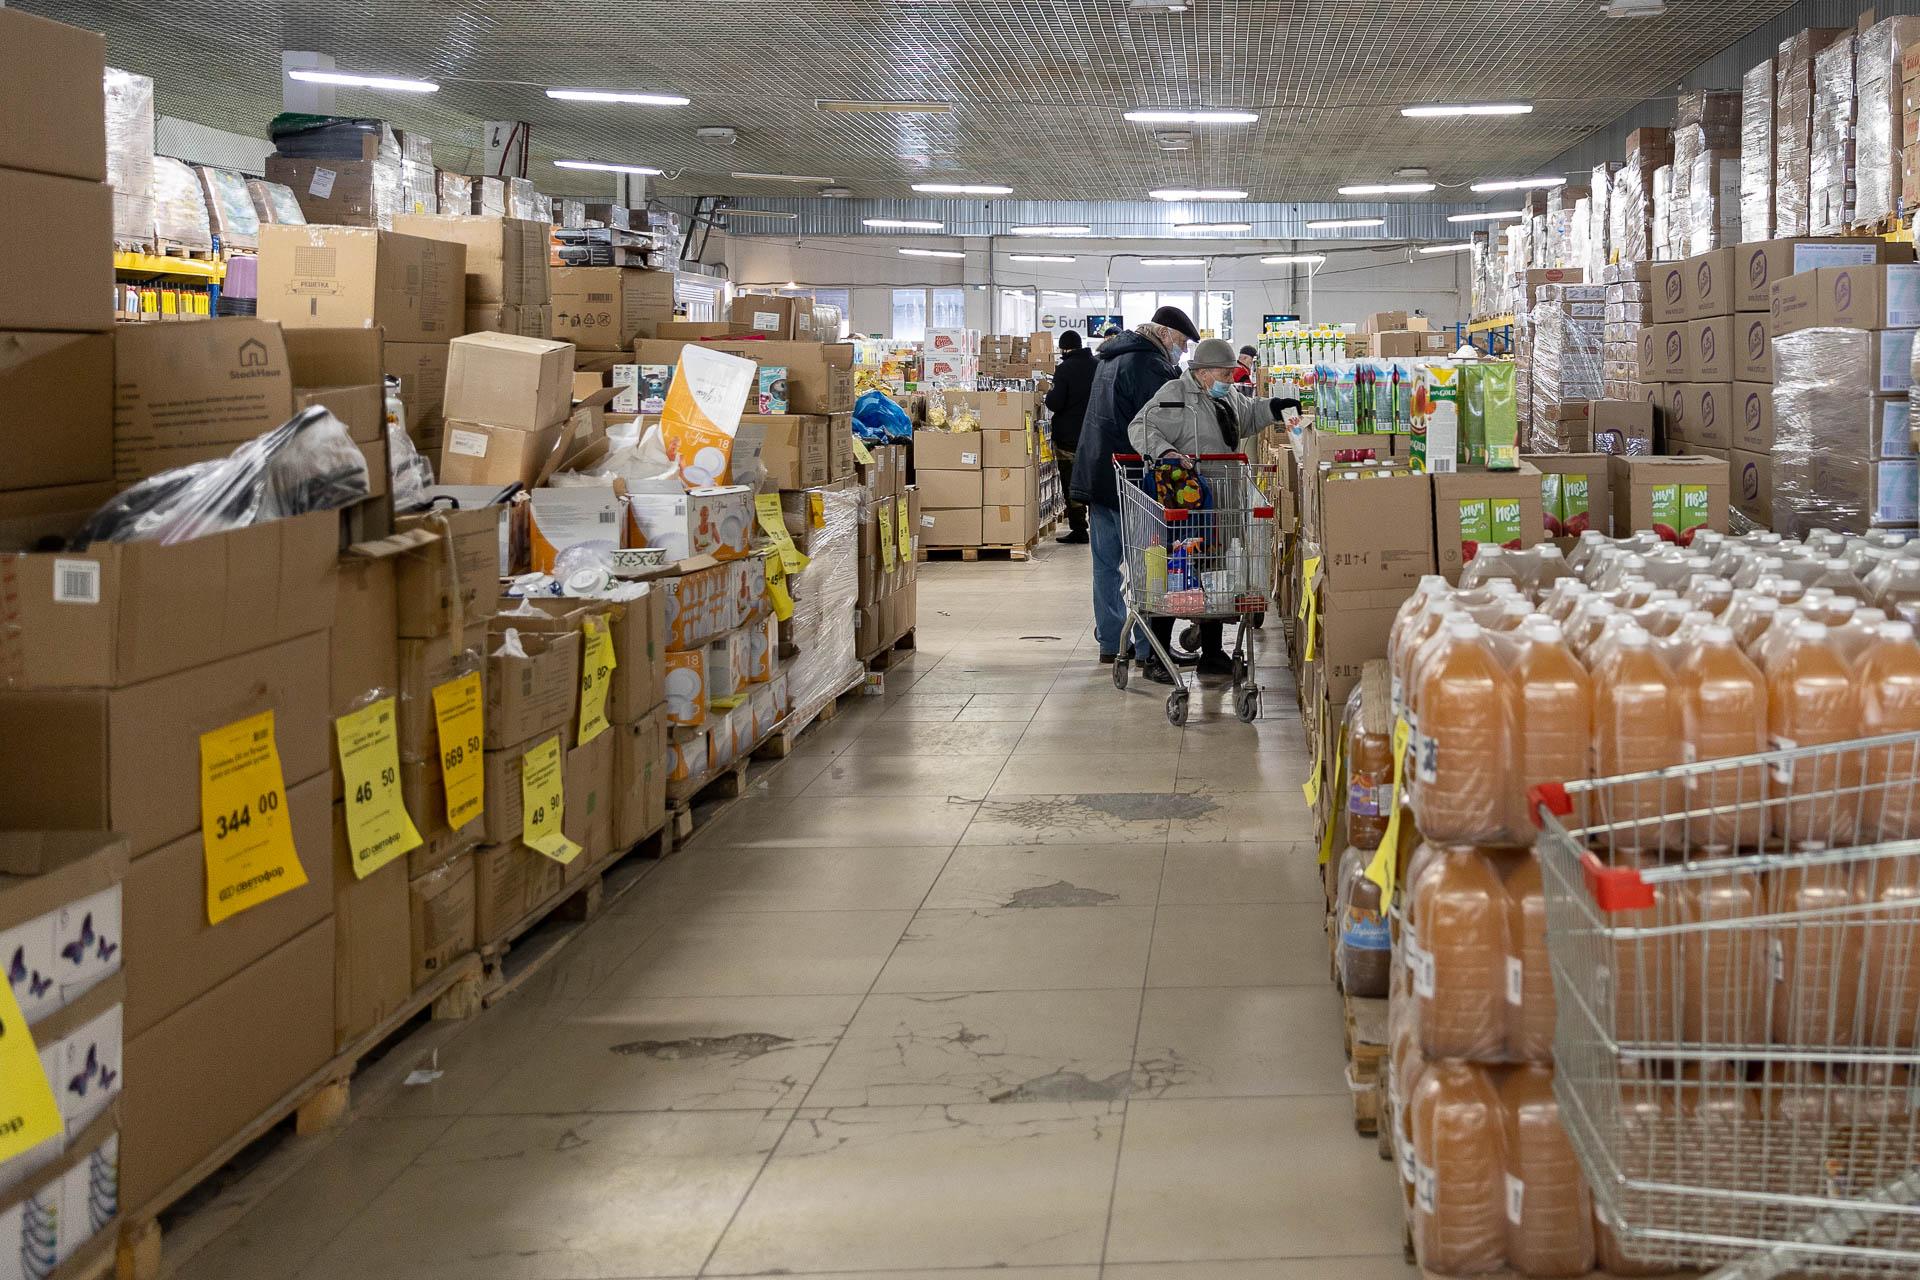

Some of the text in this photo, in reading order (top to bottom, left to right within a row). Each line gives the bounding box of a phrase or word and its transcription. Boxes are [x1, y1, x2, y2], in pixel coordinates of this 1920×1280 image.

[300, 281, 329, 289] РЕШЕТКА
[1568, 289, 1602, 299] 214
[1059, 315, 1087, 328] Бил
[1439, 388, 1457, 397] GOLD
[718, 438, 730, 449] 18
[667, 583, 679, 593] 18
[685, 655, 699, 666] 18
[445, 735, 480, 770] 669 50
[355, 767, 395, 805] 46 50
[216, 790, 279, 840] 344 00
[532, 793, 560, 826] 49 90
[236, 866, 285, 893] светофор
